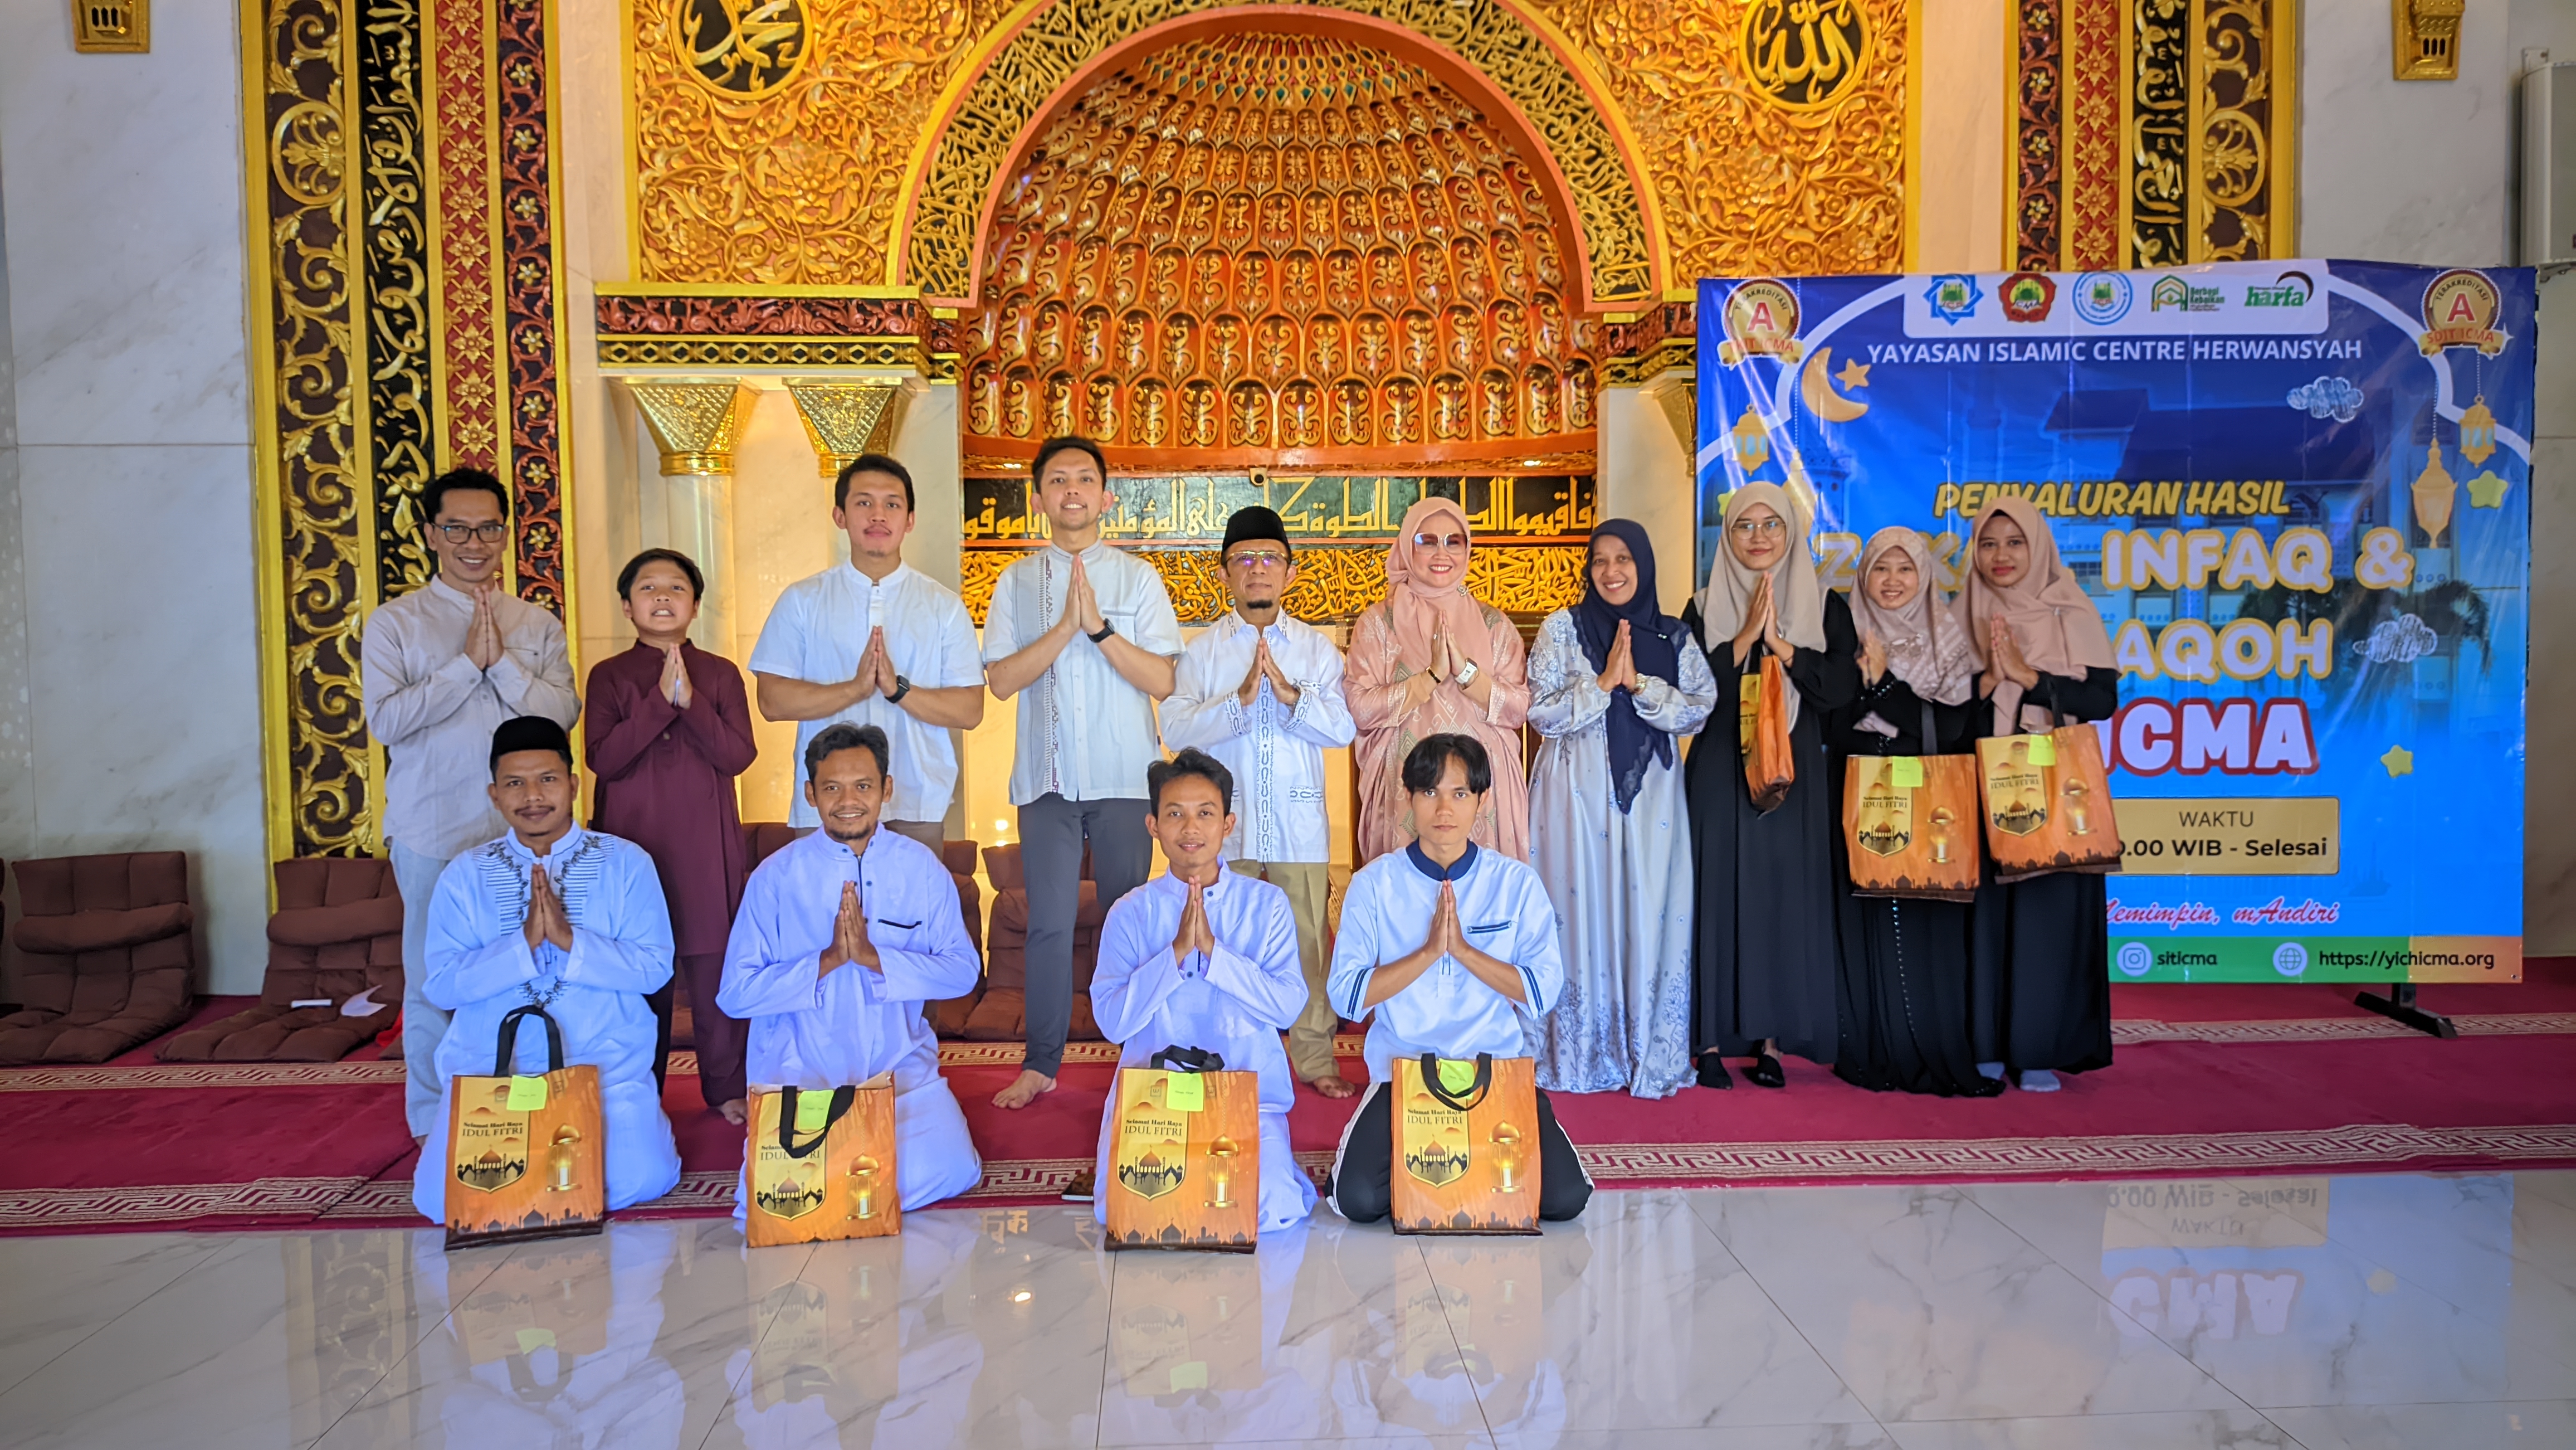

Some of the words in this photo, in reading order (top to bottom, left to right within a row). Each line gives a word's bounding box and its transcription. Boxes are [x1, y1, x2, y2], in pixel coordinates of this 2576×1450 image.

[1735, 289, 1788, 310] TAKREDITASI
[2244, 285, 2304, 306] harfa
[2436, 279, 2489, 301] TERAKREDITASI
[1747, 302, 1775, 331] A
[2446, 293, 2475, 322] A
[2427, 328, 2457, 343] SDIT
[1867, 343, 1980, 363] YAYASAN
[1988, 342, 2086, 362] ISLAMIC
[2093, 341, 2185, 361] CENTRE
[2193, 339, 2362, 360] HERWANSYAH
[2184, 480, 2290, 515] HASIL
[2102, 527, 2333, 593] INFAQ
[2354, 527, 2415, 590] &
[2112, 617, 2333, 684] AQOH
[2179, 811, 2255, 828] WAKTU
[2172, 839, 2222, 857] WIB
[2245, 837, 2328, 858] Selesai
[2232, 895, 2340, 925] mAndiri
[2157, 951, 2218, 966] siticma
[2319, 950, 2495, 970] https://yichicma.org
[1407, 1115, 1432, 1125] IDUL
[1435, 1116, 1462, 1125] FITRI
[462, 1128, 490, 1137] IDUL
[492, 1127, 523, 1136] FITRI
[1125, 1126, 1151, 1135] IDUL
[1154, 1126, 1182, 1136] FITRI
[760, 1151, 789, 1160] IDUL
